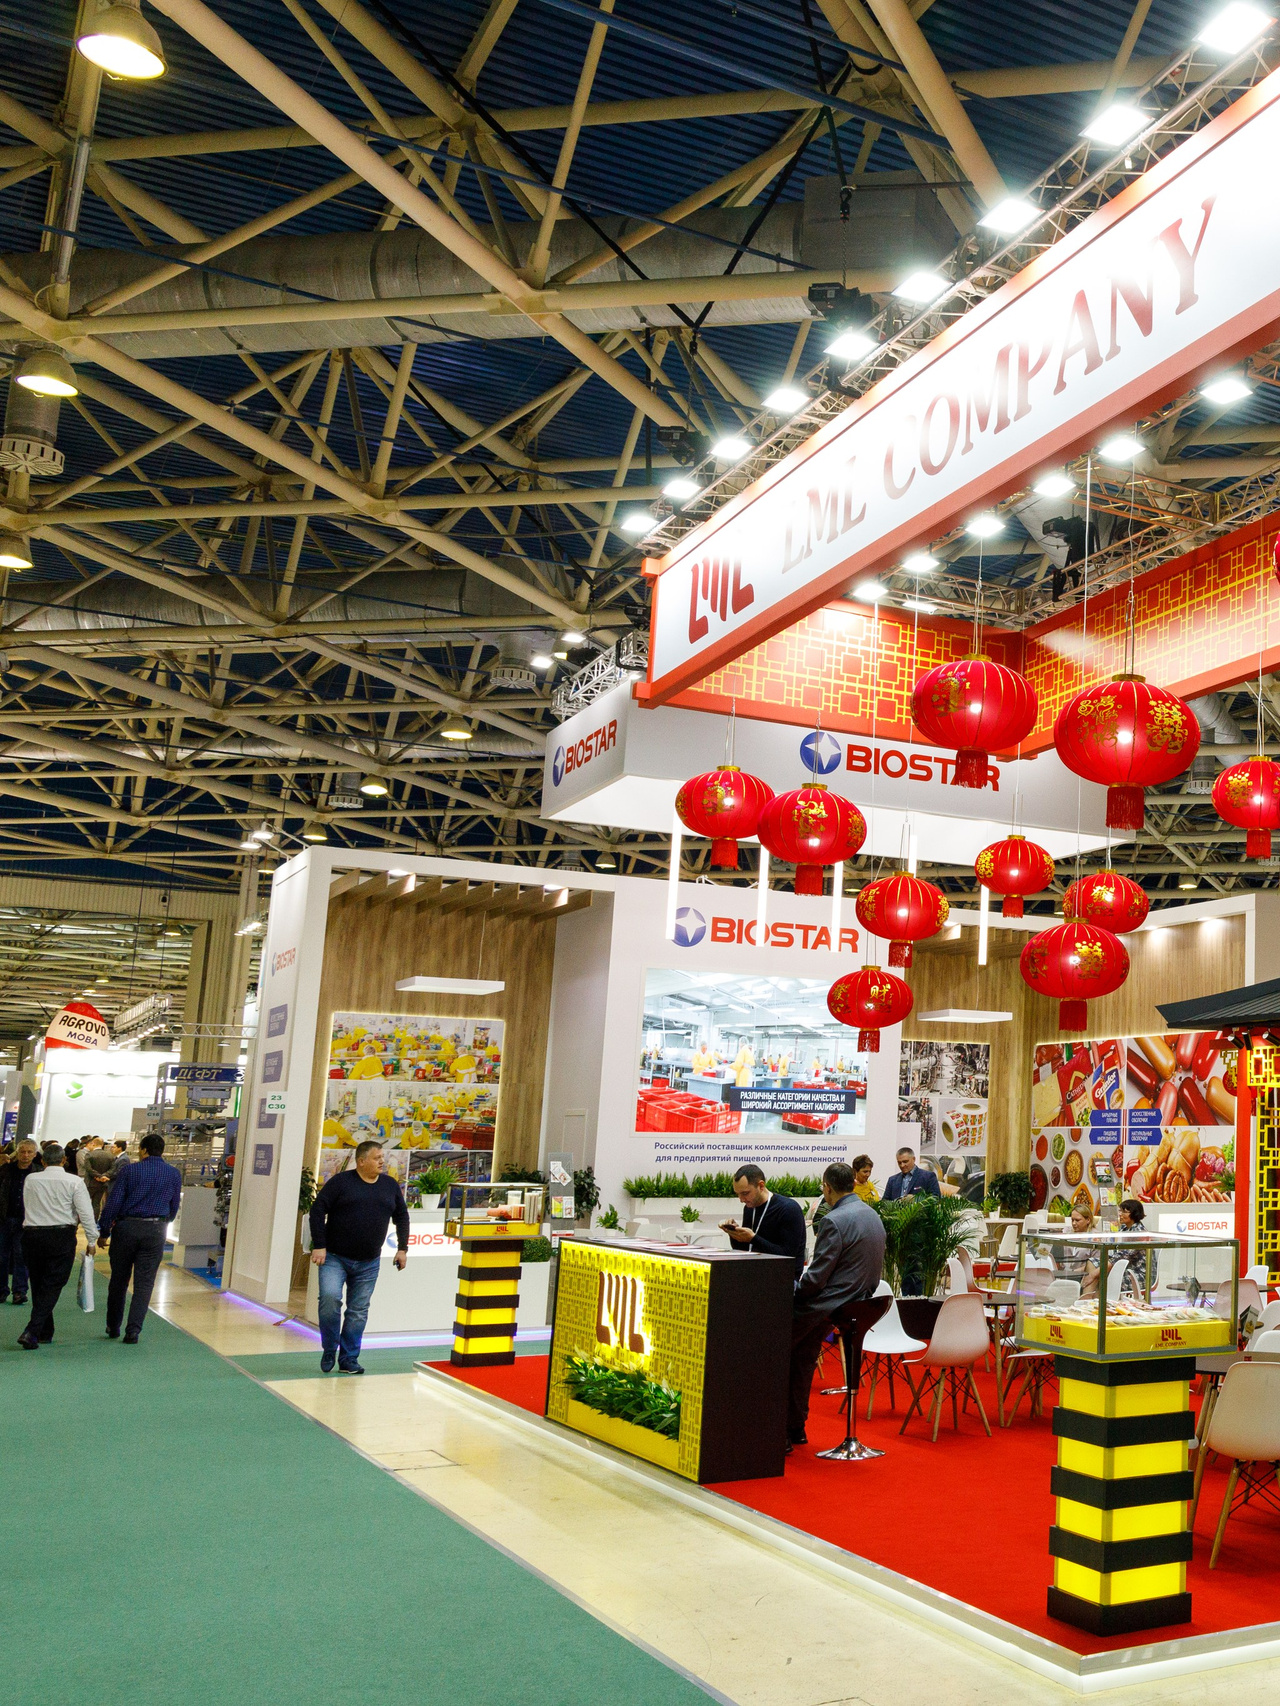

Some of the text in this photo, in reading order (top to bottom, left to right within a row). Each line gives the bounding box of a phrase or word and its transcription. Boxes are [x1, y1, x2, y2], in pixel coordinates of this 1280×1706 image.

[781, 194, 1218, 575] LML COMPANY
[564, 719, 617, 775] BIOSTAR
[846, 744, 1001, 792] BIOSTR
[711, 916, 859, 953] BIOSTAR
[740, 1091, 777, 1100] РАЗЛИЧНЫЕ
[777, 1092, 811, 1101] КАТЕГОРИИ
[811, 1093, 840, 1102] КАЧЕСТВА
[741, 1100, 845, 1111] ШИРОКИЙ АССОРТИМЕНТ КАЛИБРОВ
[654, 1142, 848, 1152] Российский поставщик комплексных решений
[673, 1154, 732, 1163] предприятий
[733, 1155, 771, 1163] пищевой
[1187, 1221, 1228, 1231] BIOSTAR
